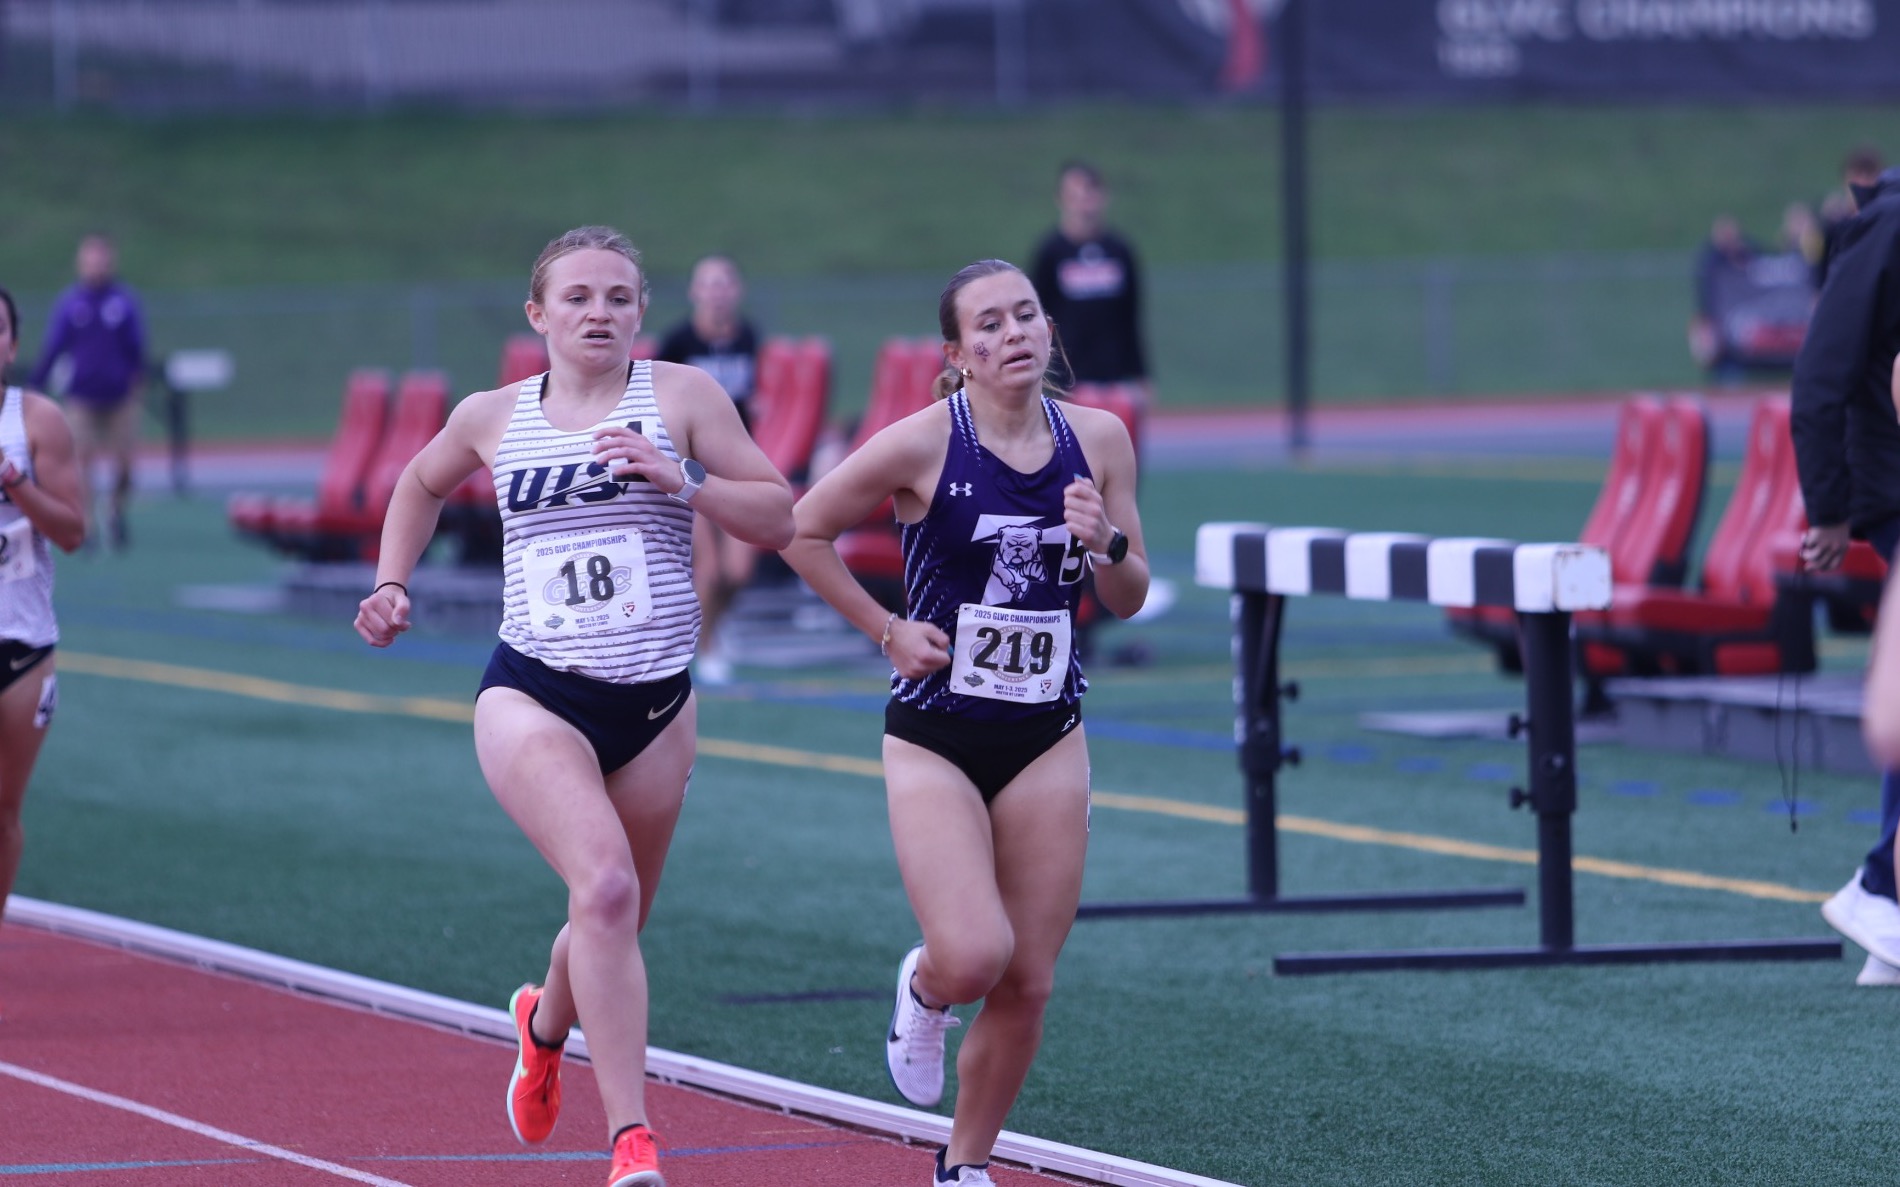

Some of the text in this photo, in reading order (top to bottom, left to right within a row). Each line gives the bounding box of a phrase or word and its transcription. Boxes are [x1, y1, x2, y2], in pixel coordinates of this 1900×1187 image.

[507, 461, 630, 513] UIS
[536, 546, 554, 557] 2025
[555, 543, 572, 554] GLVC
[572, 534, 627, 551] CHAMPIONSHIPS
[560, 555, 615, 606] 18
[974, 609, 1061, 624] 2025 GLVC CHAMPIONSHIPS
[972, 626, 1054, 675] 219
